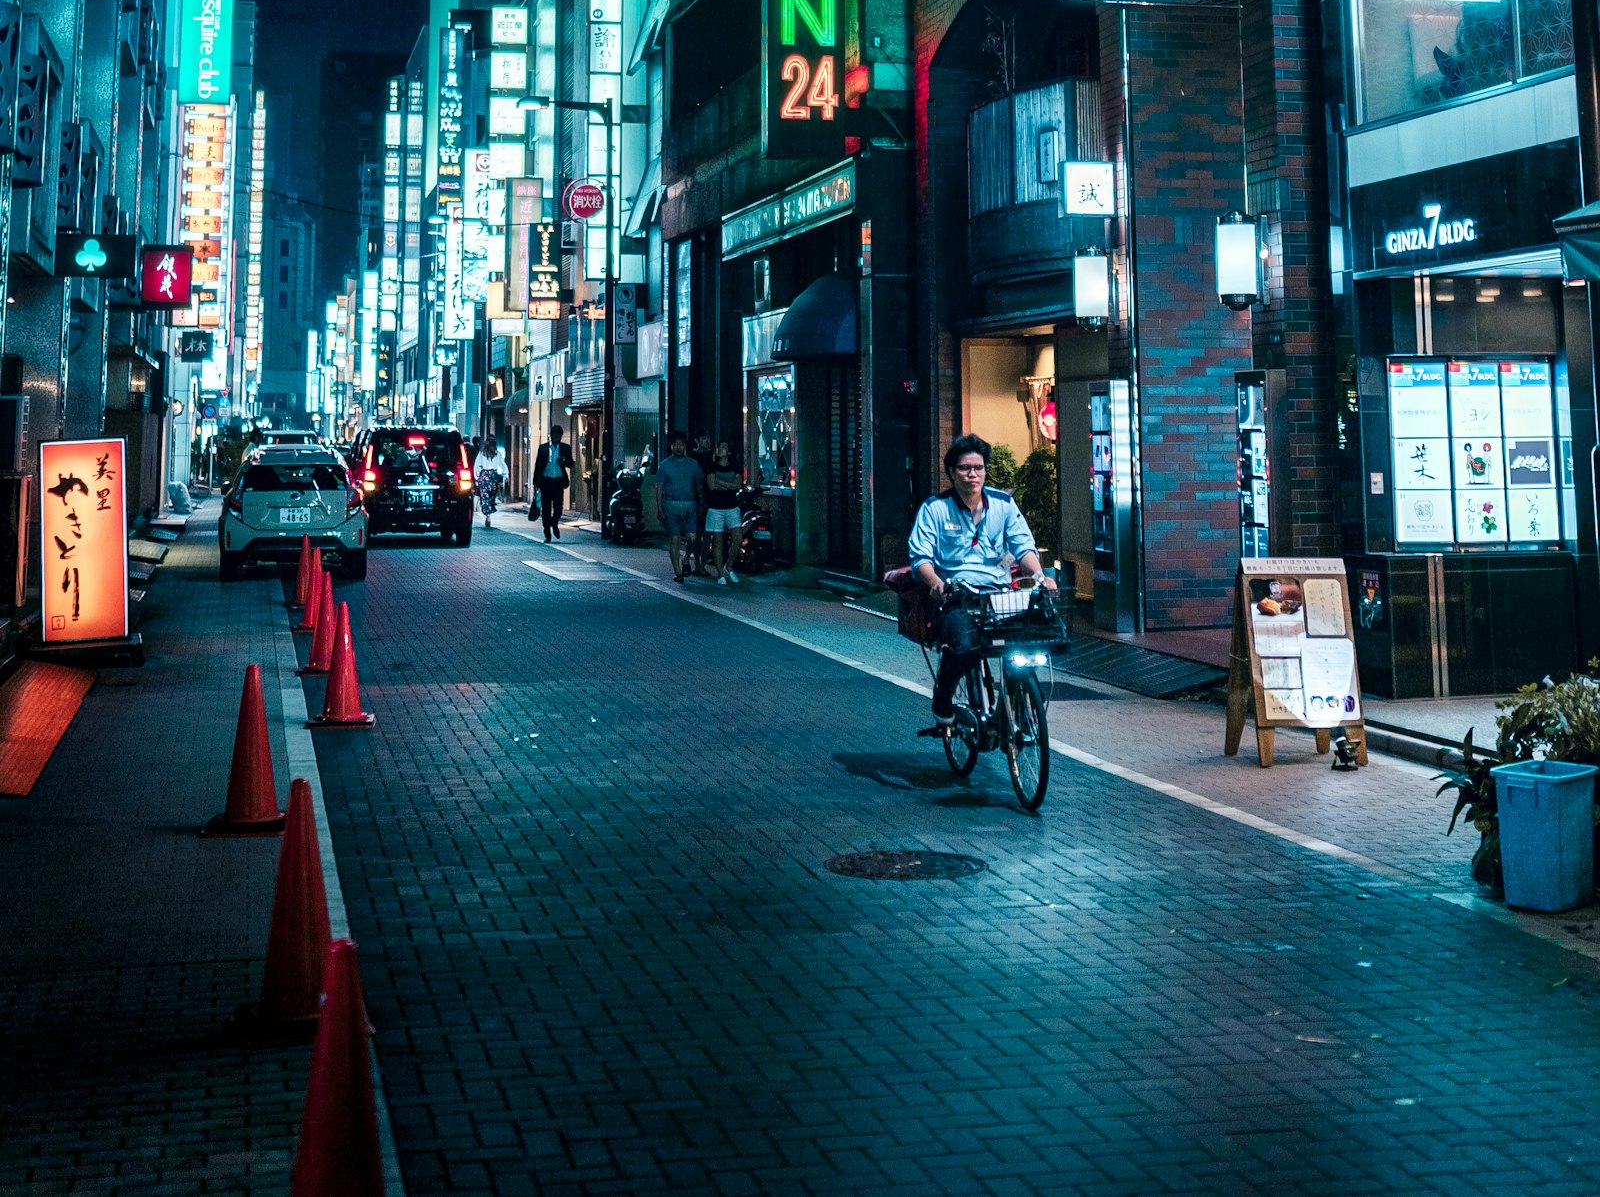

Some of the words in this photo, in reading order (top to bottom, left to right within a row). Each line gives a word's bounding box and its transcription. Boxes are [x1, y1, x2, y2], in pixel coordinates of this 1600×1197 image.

[197, 57, 220, 99] club
[781, 54, 839, 120] 24
[516, 185, 537, 196] 銀座
[573, 194, 602, 209] 消火栓
[1387, 228, 1427, 254] GINZA
[1423, 202, 1441, 250] 7
[184, 337, 207, 353] 林
[92, 453, 117, 511] 美里
[47, 471, 89, 622] やきとり
